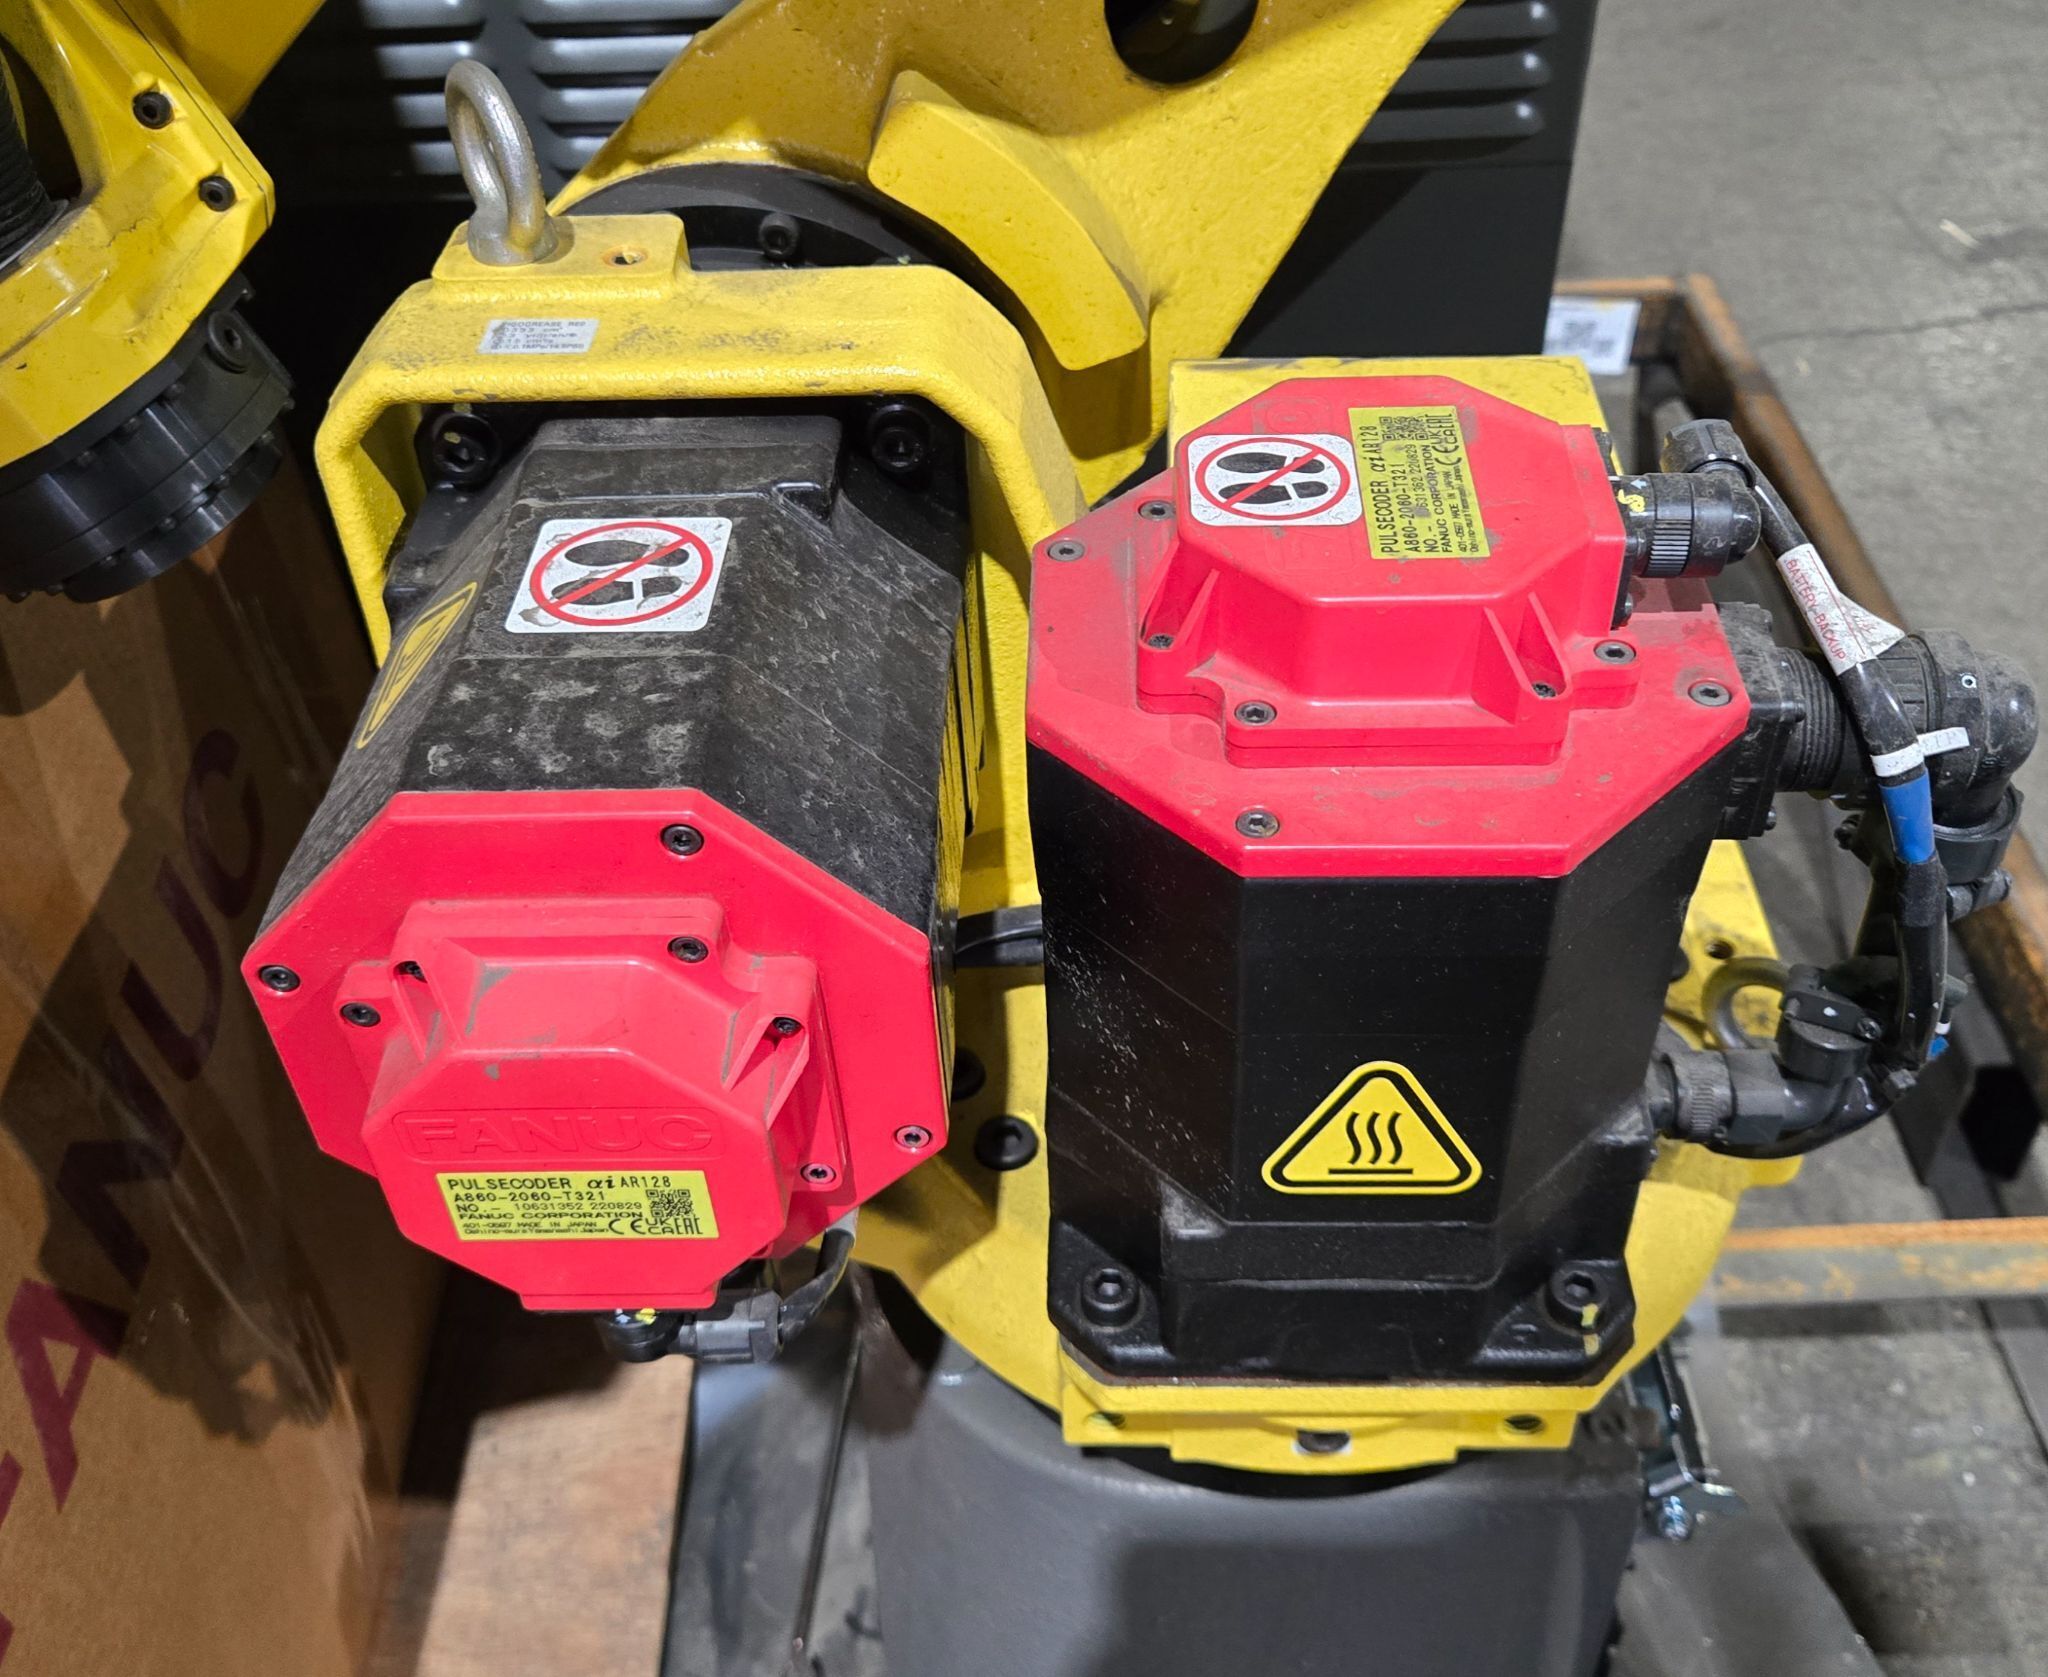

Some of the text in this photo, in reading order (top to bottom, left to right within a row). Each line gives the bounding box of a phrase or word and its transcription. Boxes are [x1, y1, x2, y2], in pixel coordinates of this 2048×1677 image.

[1389, 463, 1420, 553] A860-2060-T321
[1420, 444, 1452, 553] FANUC CORPORATION
[1447, 492, 1456, 500] IN
[1370, 481, 1400, 553] PULSECODER
[404, 1114, 713, 1154] FANUC
[447, 1177, 572, 1191] PULSECODER
[620, 1175, 672, 1188] AR128
[453, 1191, 605, 1203] A860-2060-T321
[0, 728, 264, 1668] ANUC
[514, 1202, 584, 1211] 10631352
[590, 1202, 643, 1210] 220829
[459, 1211, 643, 1220] FANUC CORPORATION
